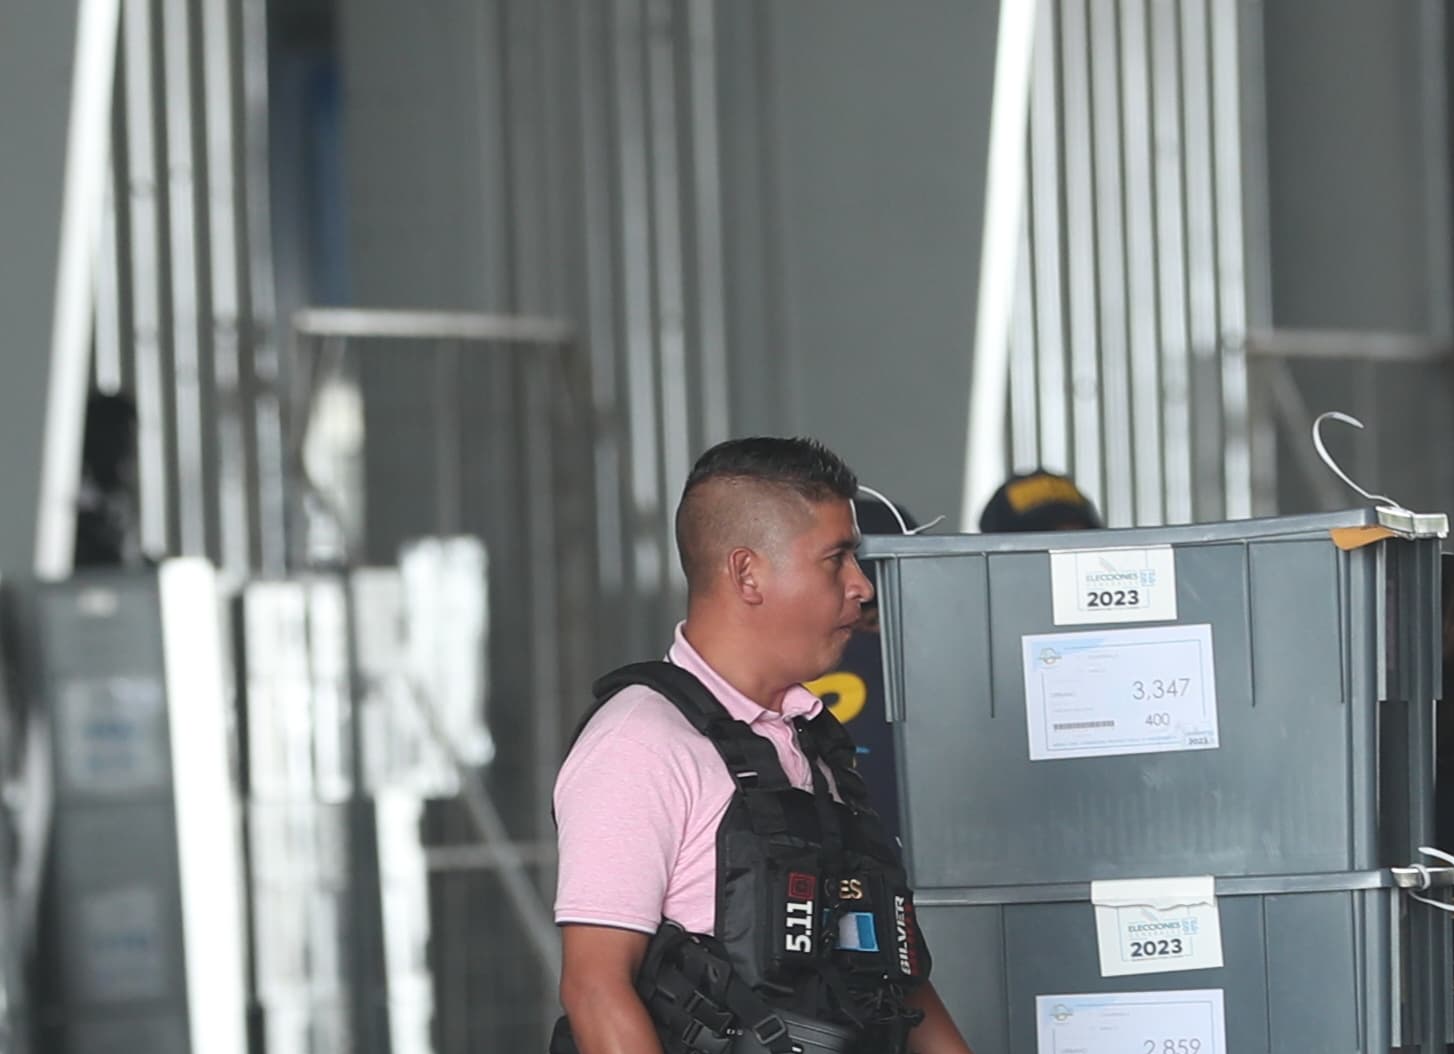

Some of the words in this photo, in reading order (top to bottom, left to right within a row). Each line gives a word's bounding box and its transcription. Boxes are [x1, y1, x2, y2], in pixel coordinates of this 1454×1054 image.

[1087, 589, 1140, 607] 2023
[1132, 678, 1191, 701] 3,347
[1145, 712, 1170, 726] 400
[786, 900, 814, 953] 5.11
[1128, 921, 1181, 933] ELECCIONES
[1130, 938, 1184, 958] 2023
